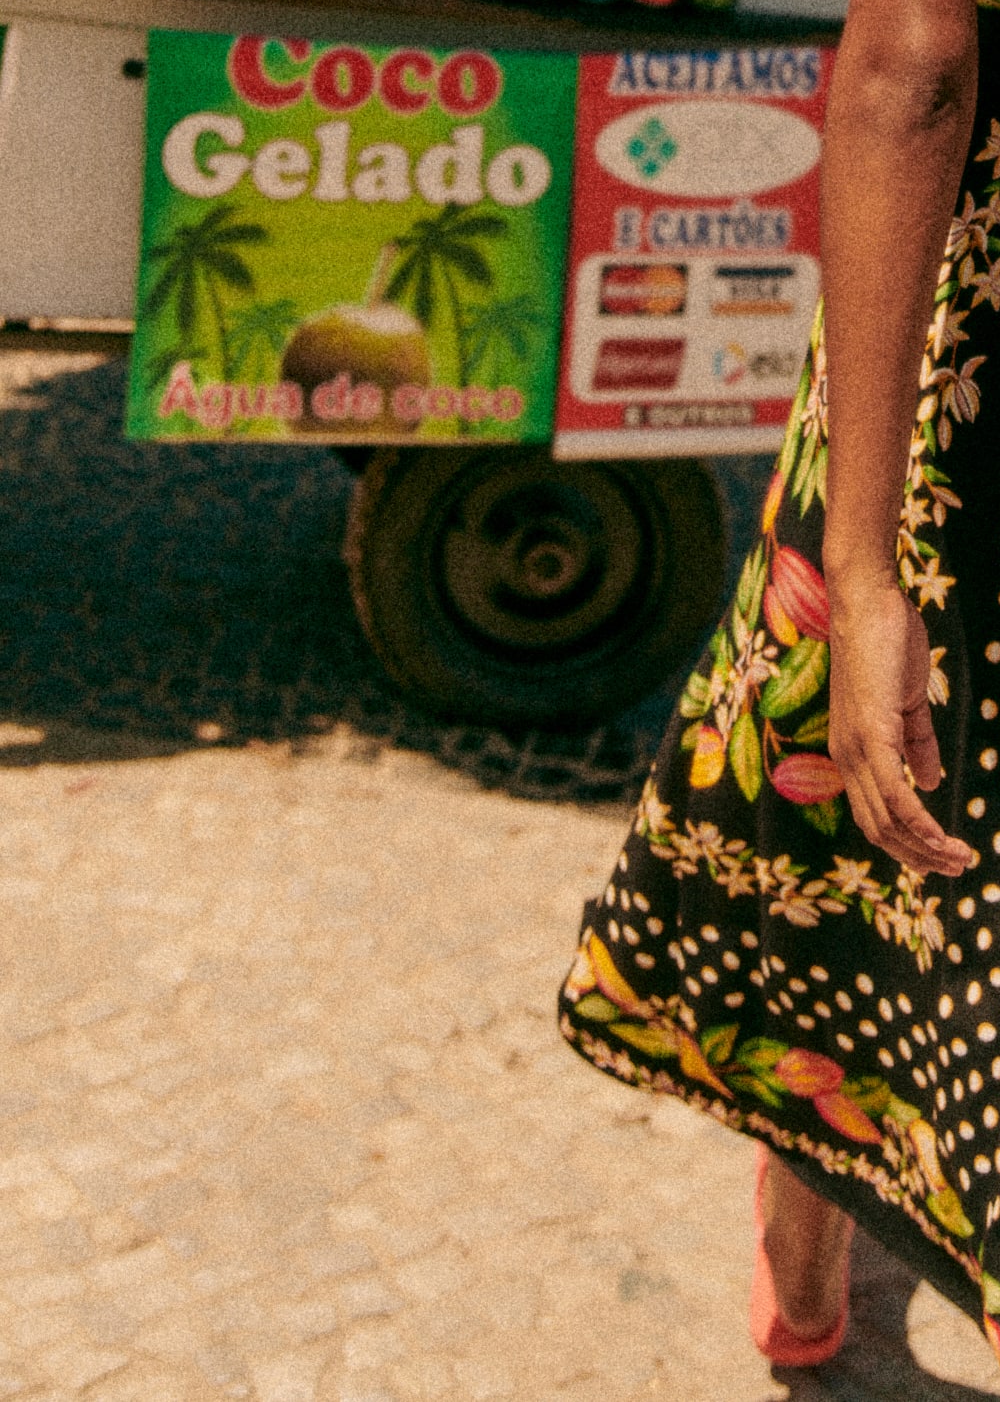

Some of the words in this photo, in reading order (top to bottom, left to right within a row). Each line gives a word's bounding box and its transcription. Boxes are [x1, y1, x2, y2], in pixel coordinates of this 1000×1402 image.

[228, 35, 502, 114] Coco
[162, 112, 552, 206] Gelado
[313, 372, 382, 420] de
[391, 384, 525, 422] coco
